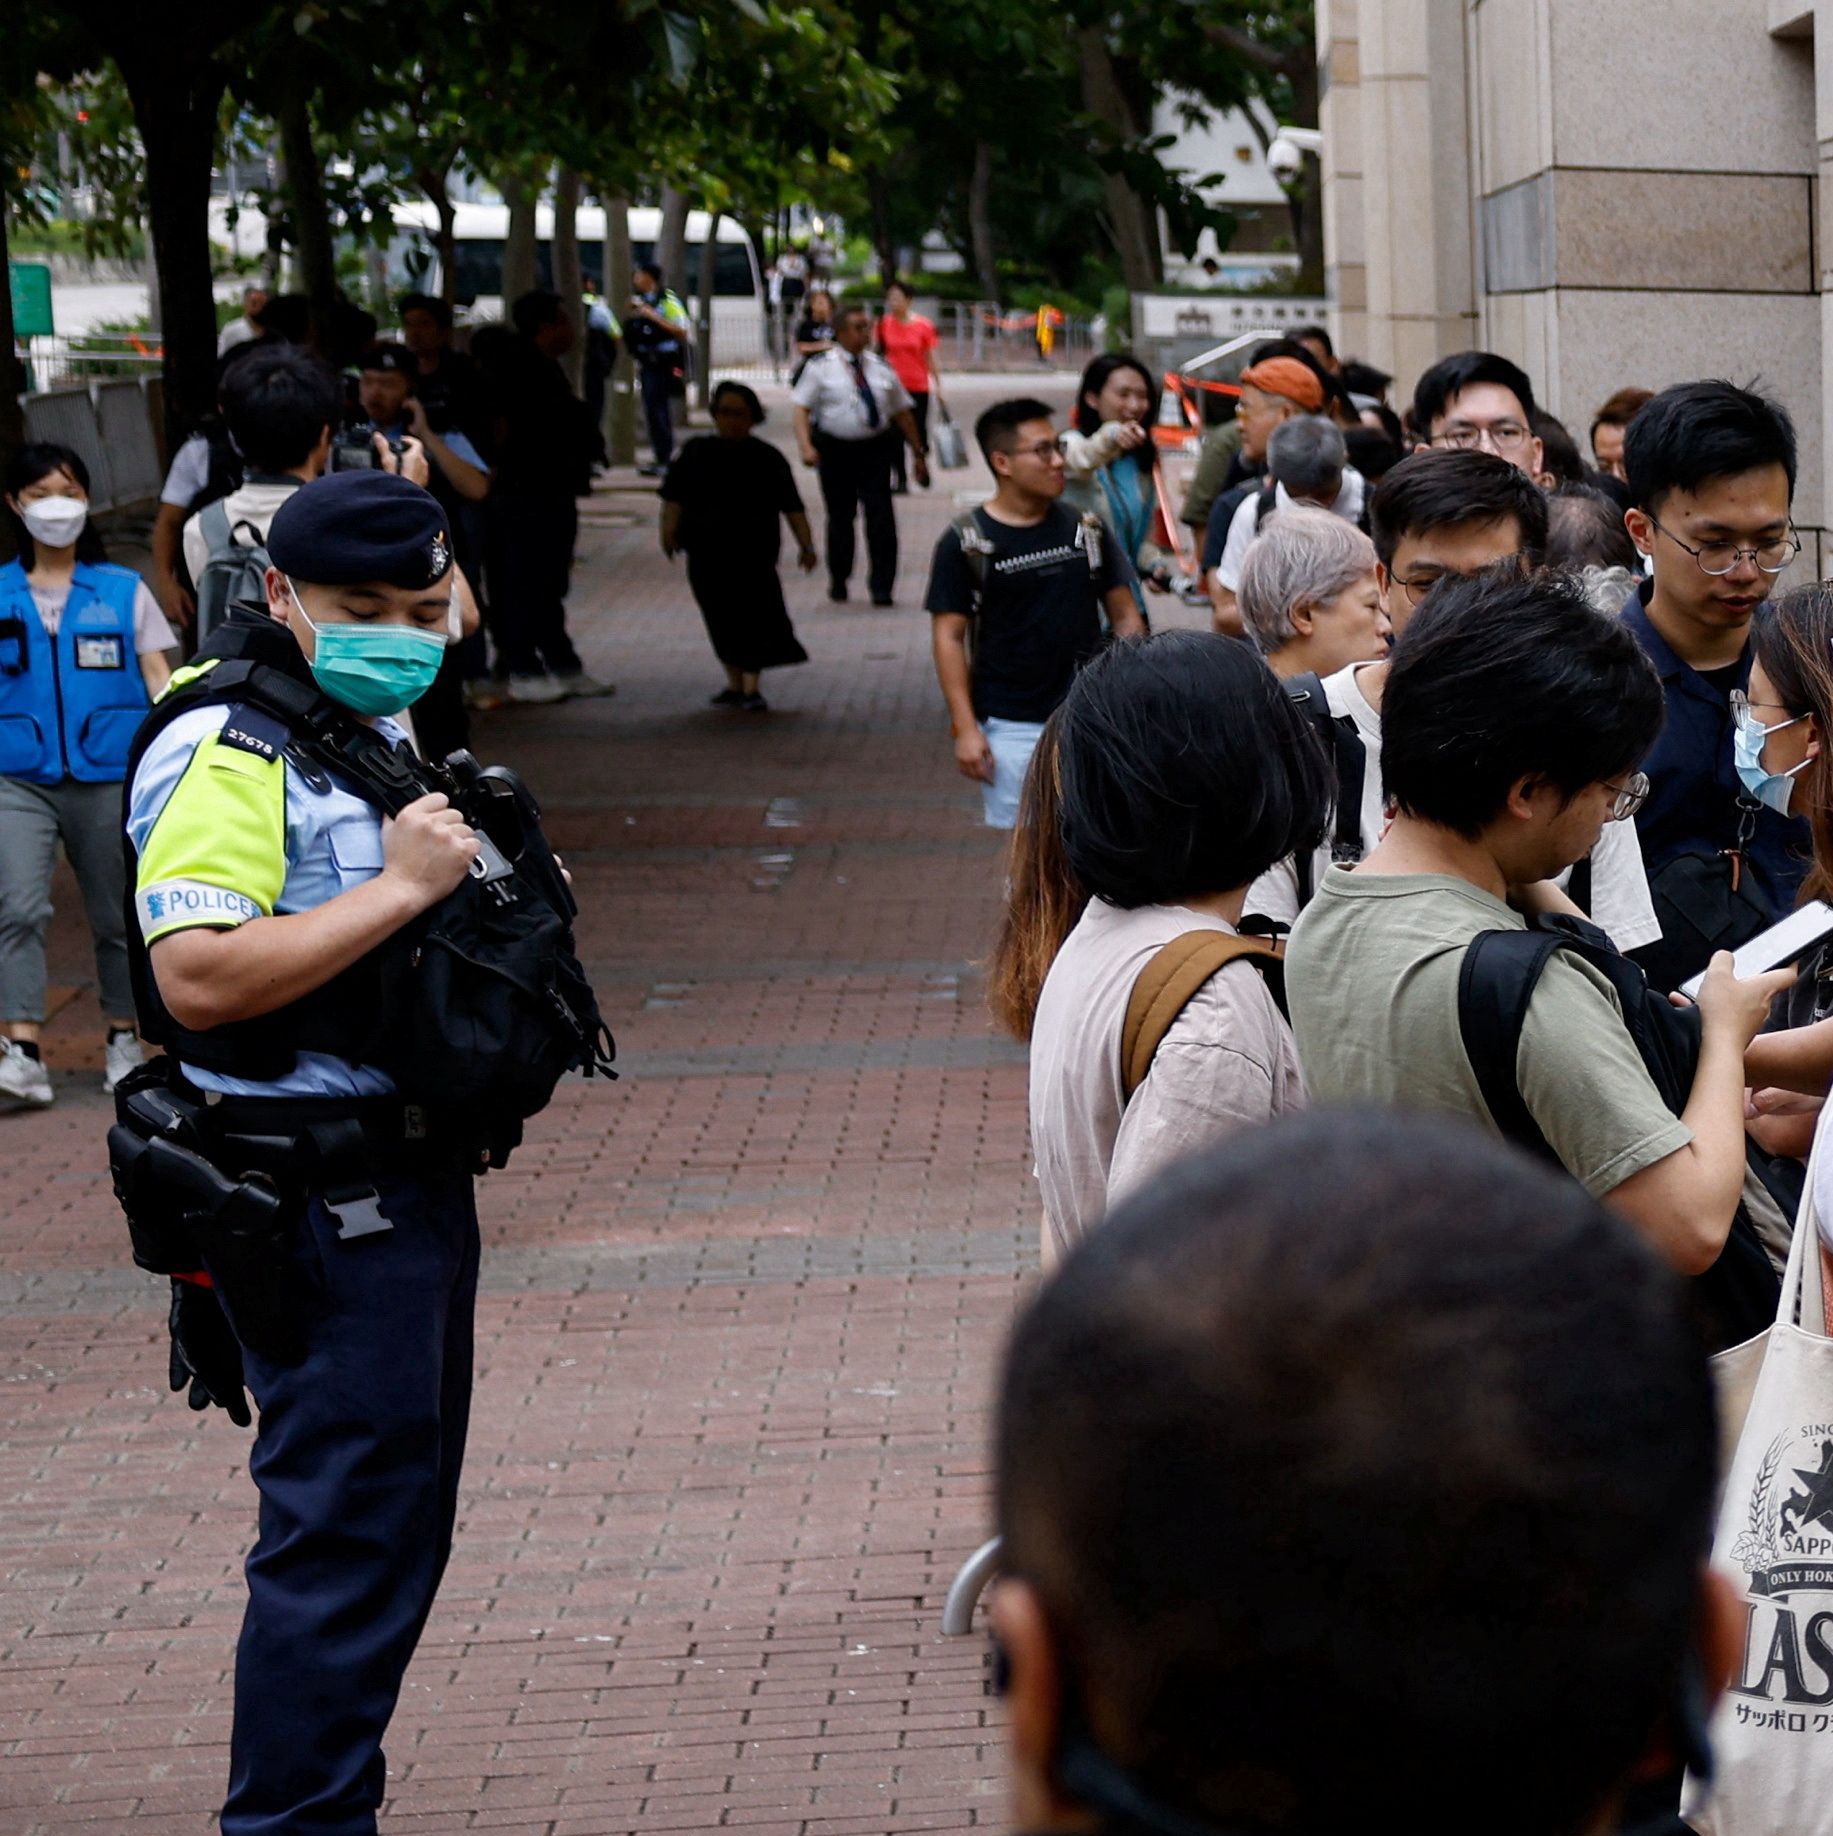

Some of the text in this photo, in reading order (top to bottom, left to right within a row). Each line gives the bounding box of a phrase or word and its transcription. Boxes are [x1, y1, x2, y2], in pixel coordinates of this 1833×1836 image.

[227, 728, 273, 754] 27678
[169, 889, 251, 918] POLICE
[1770, 1570, 1802, 1586] ONLY
[1736, 1703, 1806, 1732] サッポロ
